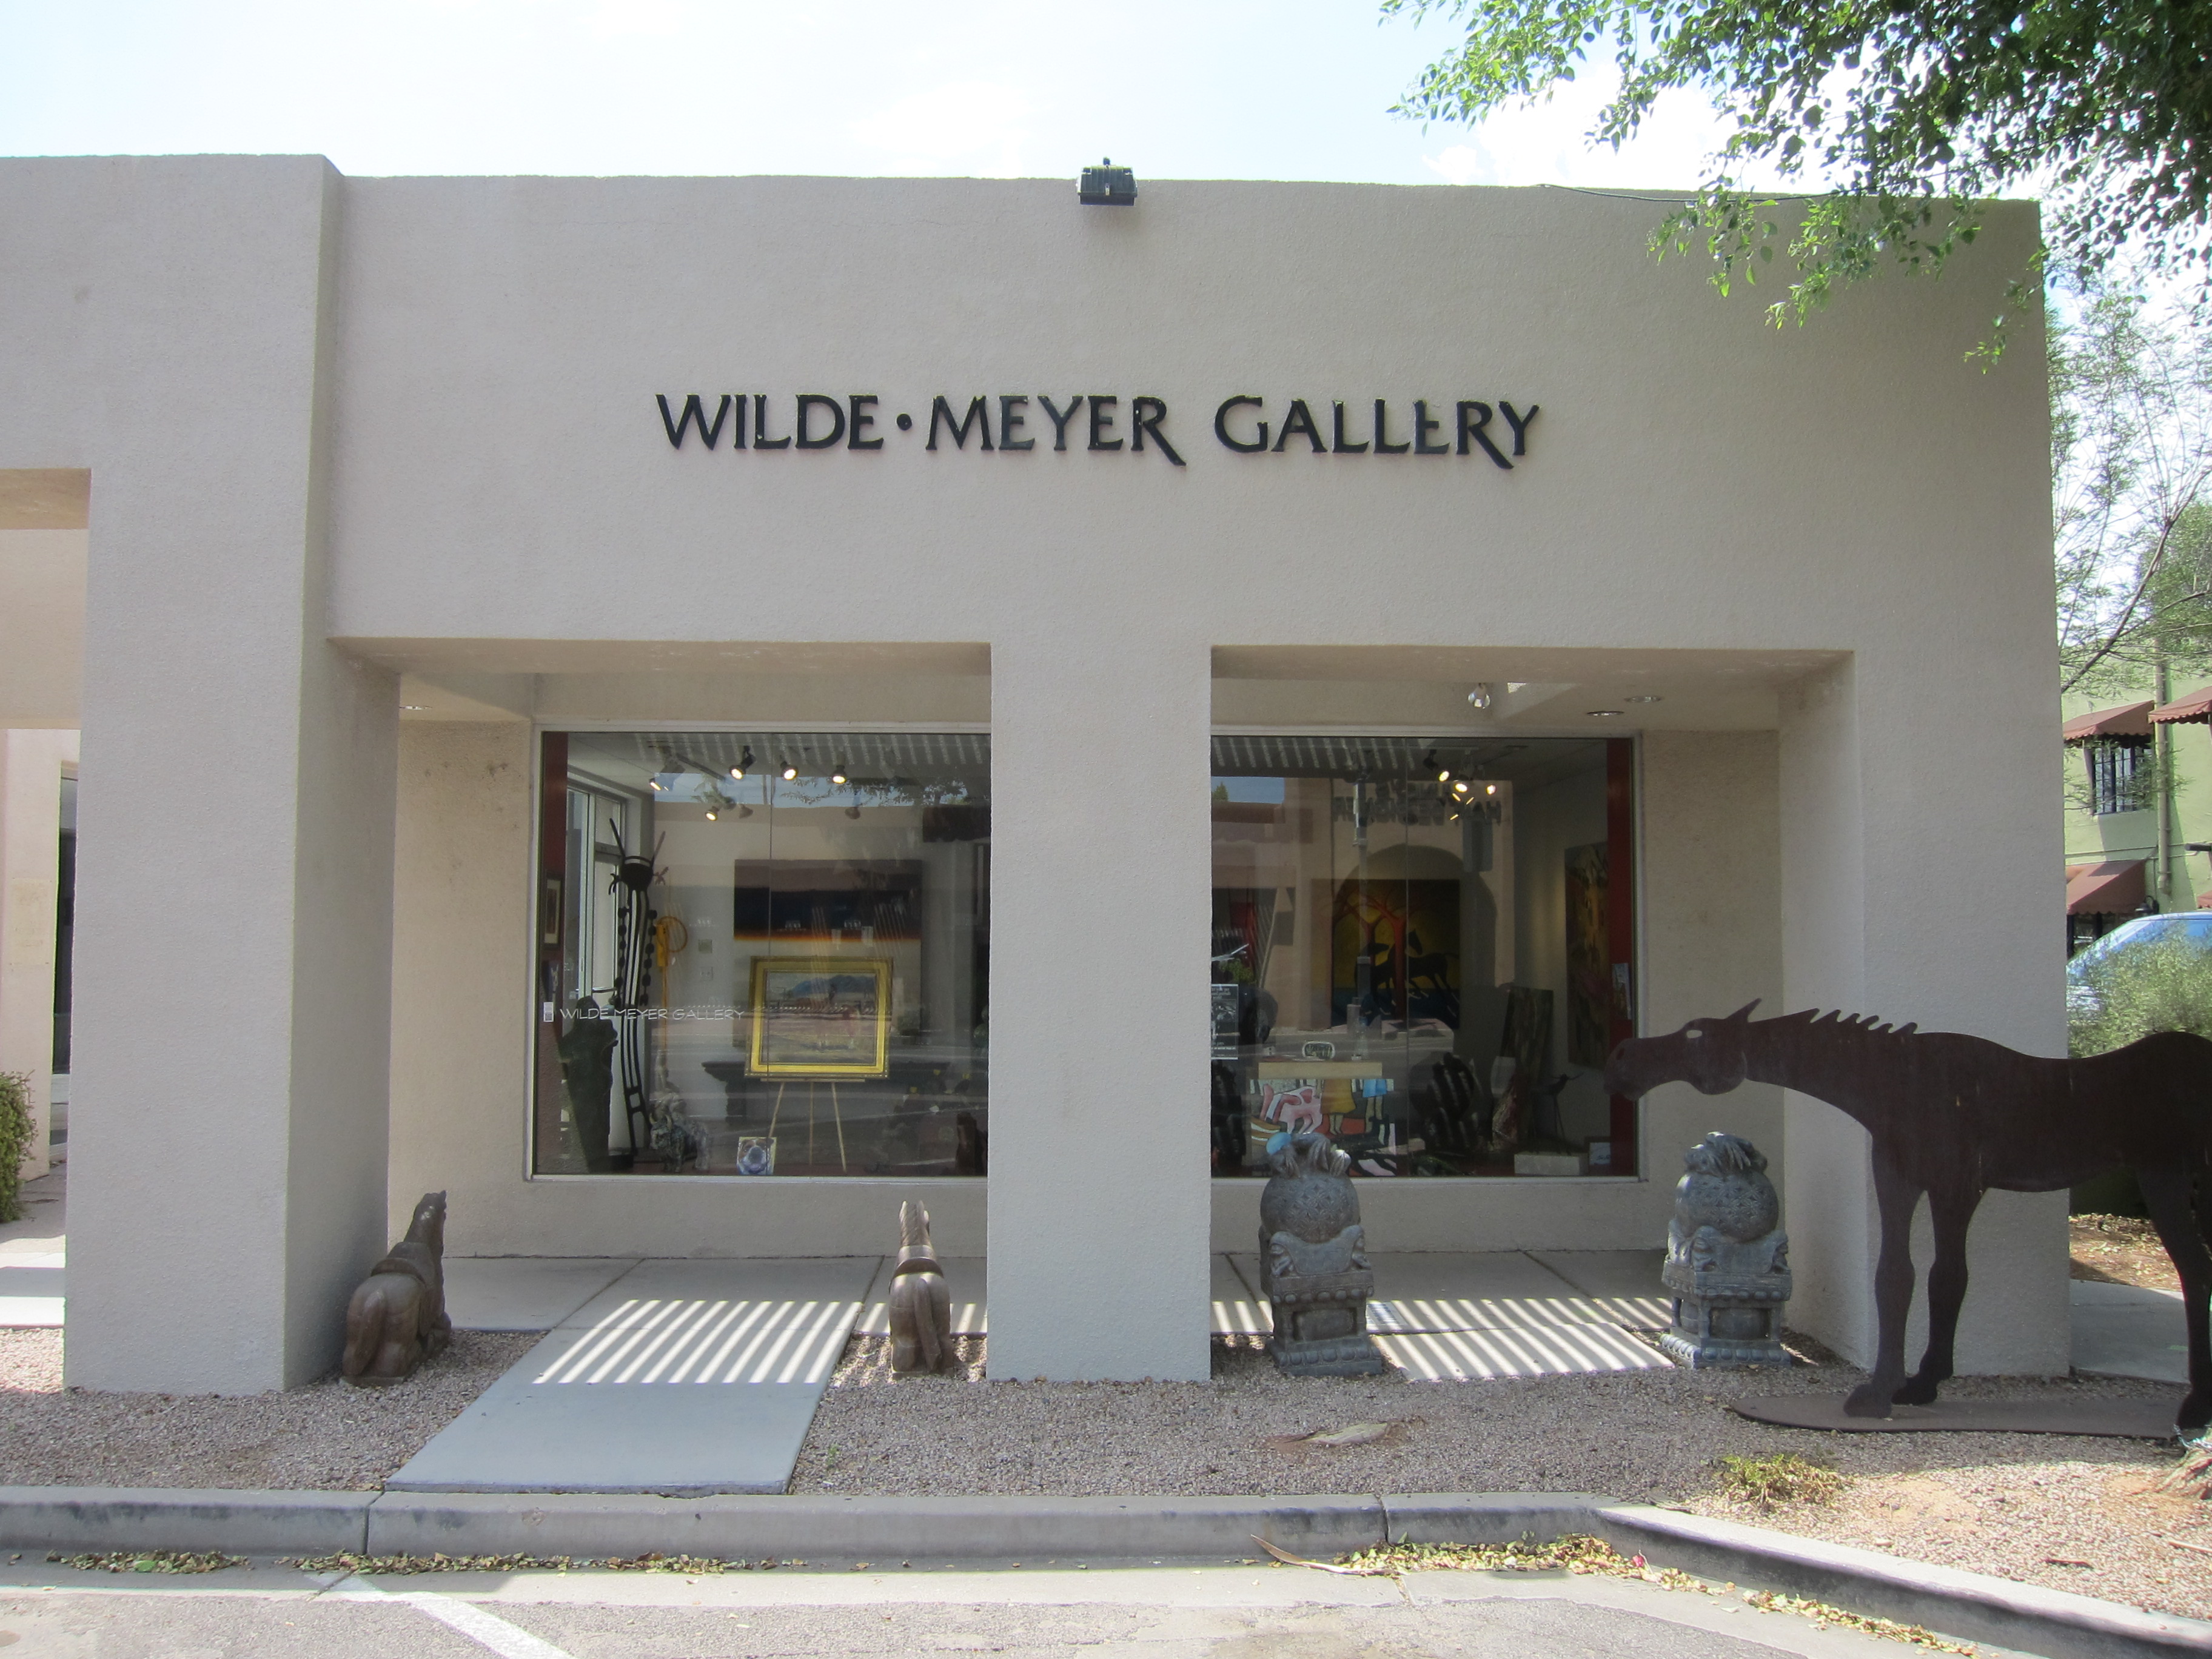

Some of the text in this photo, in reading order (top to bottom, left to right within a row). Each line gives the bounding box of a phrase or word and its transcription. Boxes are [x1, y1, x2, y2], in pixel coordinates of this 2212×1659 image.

[1215, 395, 1540, 469] GALLERY
[559, 1008, 609, 1020] WILDE
[614, 1008, 668, 1020] MEYER
[672, 1008, 745, 1021] GALLERY
